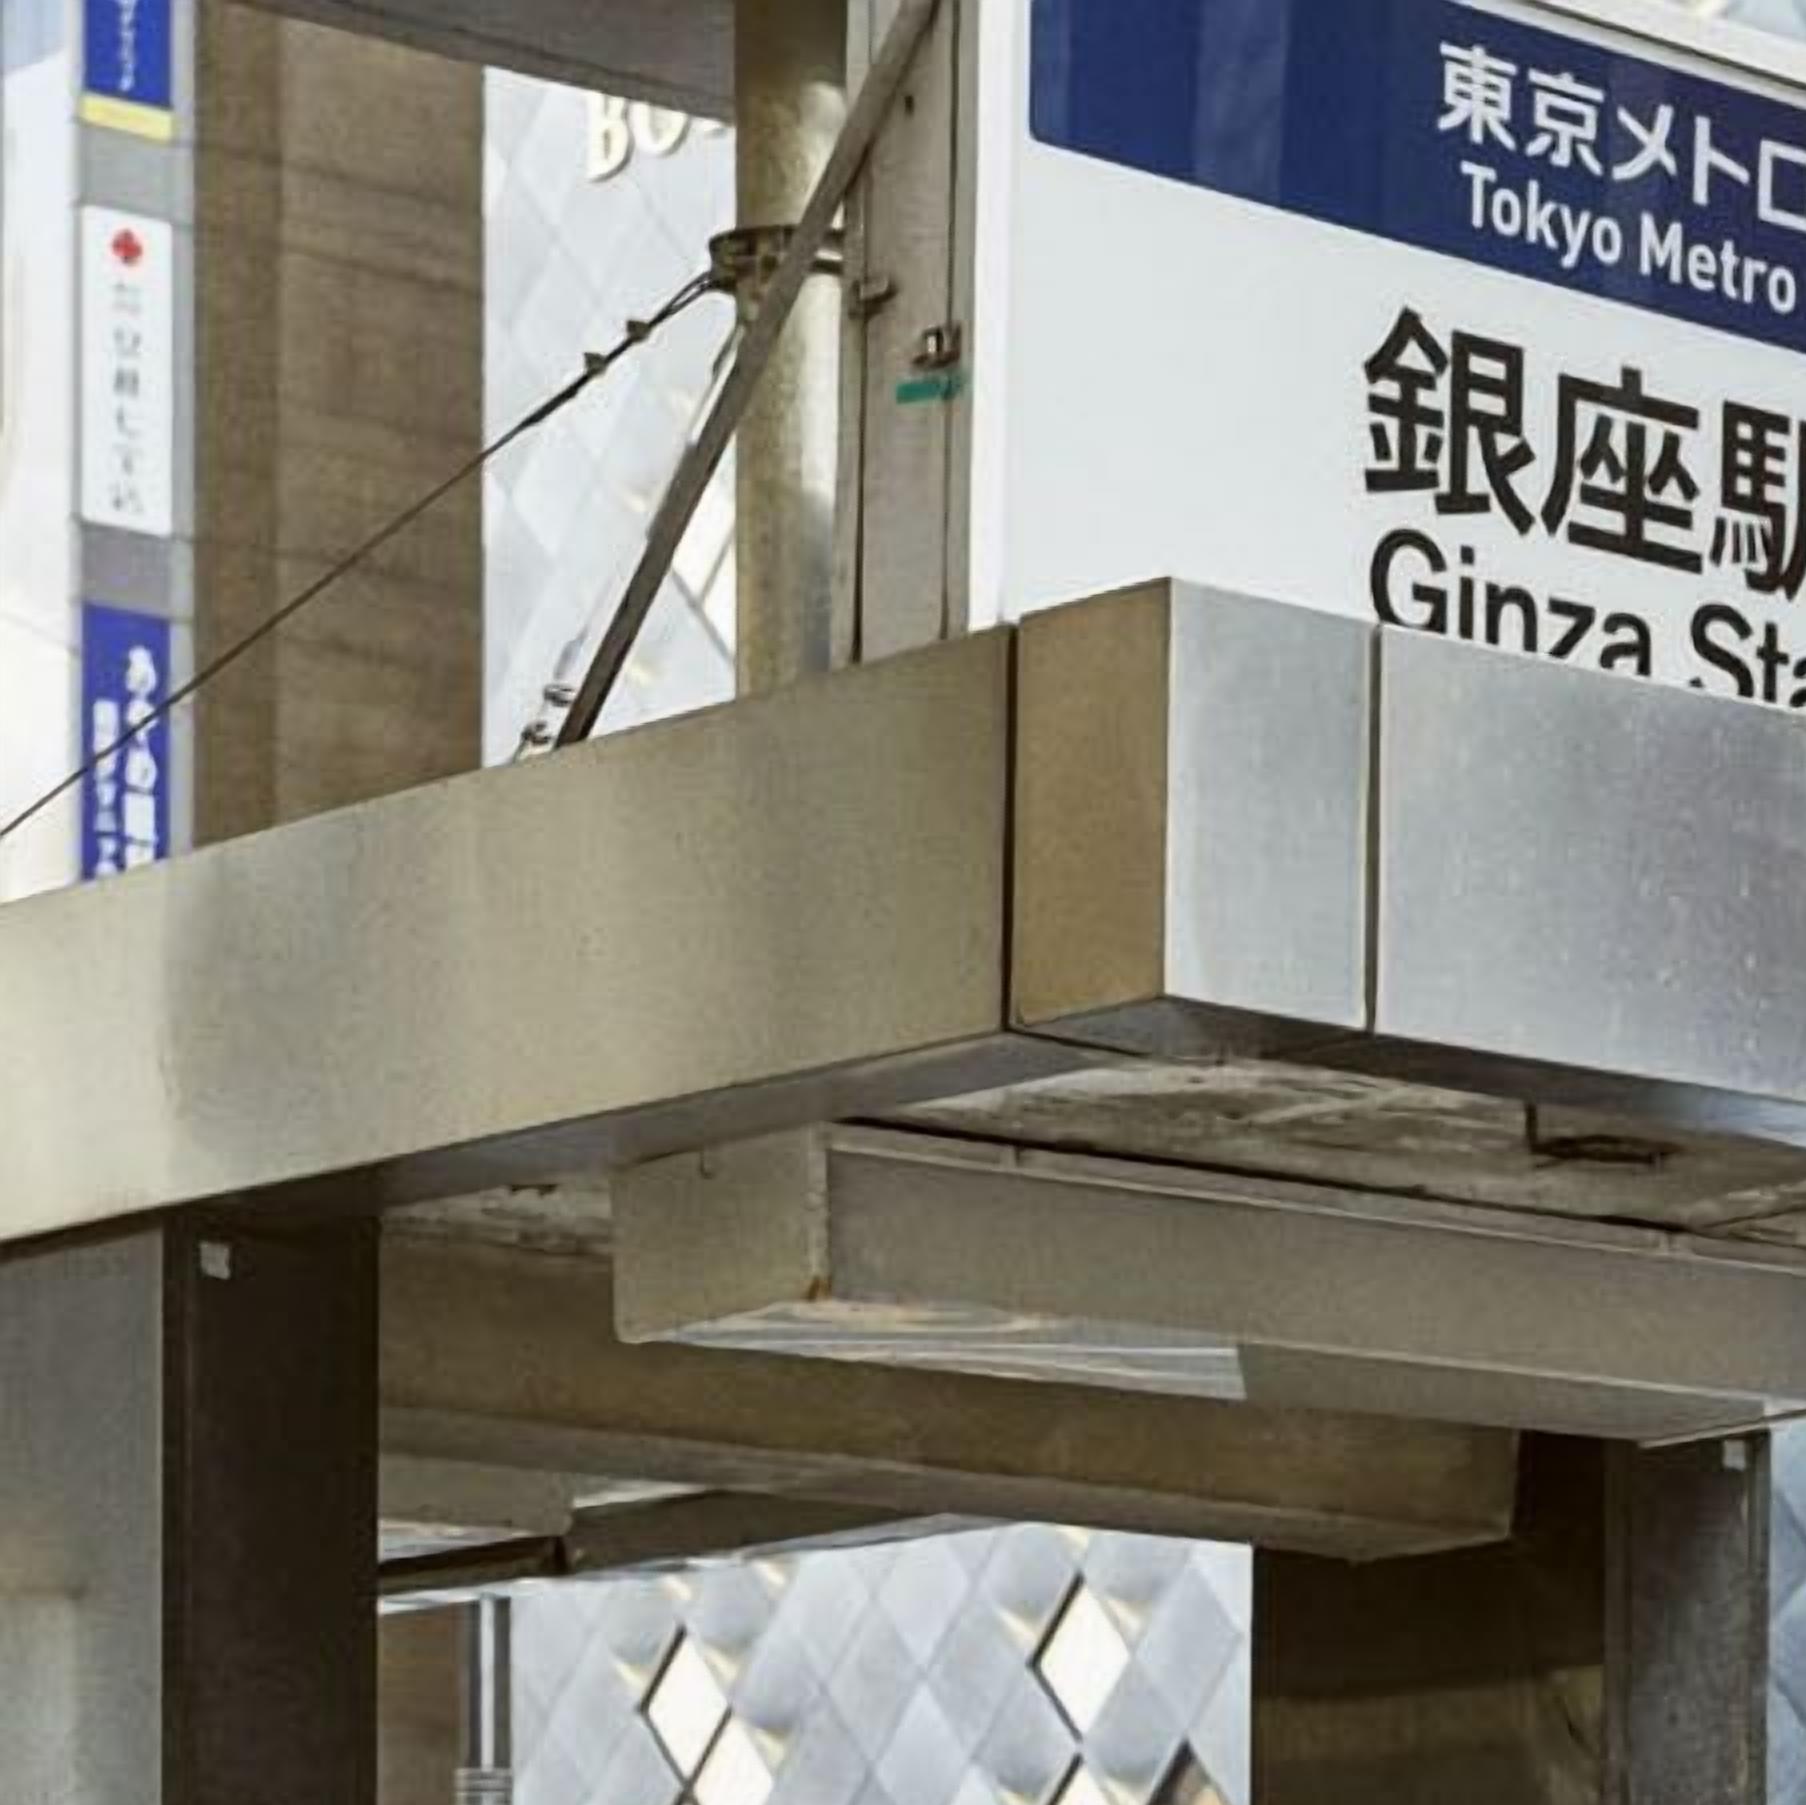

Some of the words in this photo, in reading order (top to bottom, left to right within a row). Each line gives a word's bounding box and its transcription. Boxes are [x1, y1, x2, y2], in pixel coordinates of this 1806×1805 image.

[1461, 160, 1622, 270] Tokyo
[1640, 212, 1798, 315] Metro
[1370, 528, 1652, 679] Ginza
